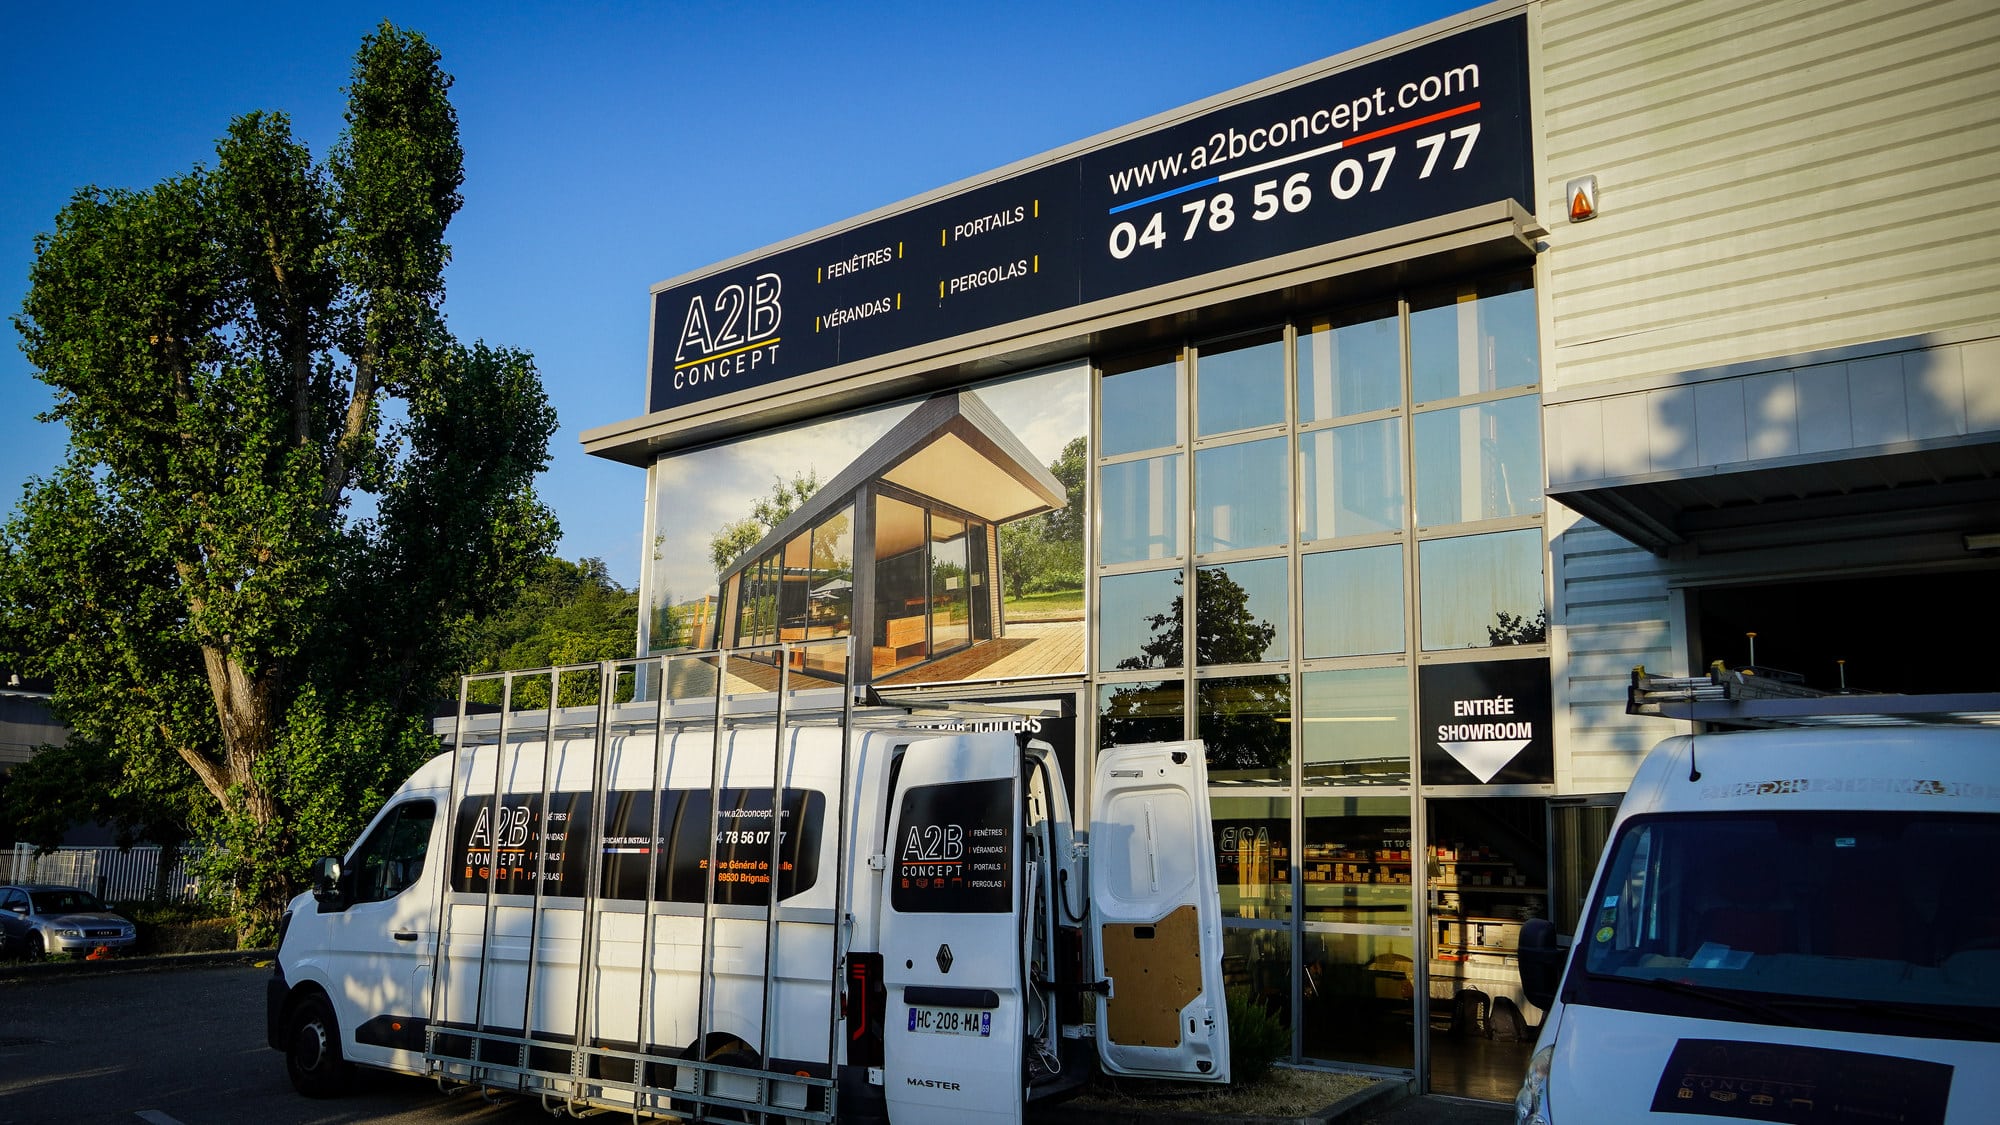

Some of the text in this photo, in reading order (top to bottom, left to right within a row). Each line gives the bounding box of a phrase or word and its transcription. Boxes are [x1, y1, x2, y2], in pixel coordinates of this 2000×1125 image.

[1109, 63, 1480, 194] www.a2bconcept.com
[1109, 123, 1481, 259] 04 78 56 07 77
[954, 206, 1025, 241] PORTAILS
[827, 246, 892, 281] FENÊTRES
[950, 260, 1028, 295] PERGOLAS
[674, 272, 782, 362] A2B
[823, 297, 891, 329] VÉRANDAS
[674, 345, 780, 390] CONCEPT
[1454, 695, 1514, 717] ENTRÉE
[1437, 722, 1532, 741] SHOWROOM
[468, 806, 530, 847] A2B
[725, 831, 738, 844] 78
[740, 831, 754, 844] 56
[756, 831, 770, 844] 07
[974, 828, 1003, 836] FENÊTRES
[902, 824, 964, 861] A2B
[972, 845, 1003, 854] VÉRANDAS
[467, 853, 525, 866] CONEPT
[729, 859, 757, 870] Général
[758, 861, 768, 870] de
[718, 872, 770, 884] 69530 Brignais
[902, 865, 963, 877] CONCEPT
[972, 880, 1002, 888] PERGOLAS
[907, 1078, 960, 1091] MASTER
